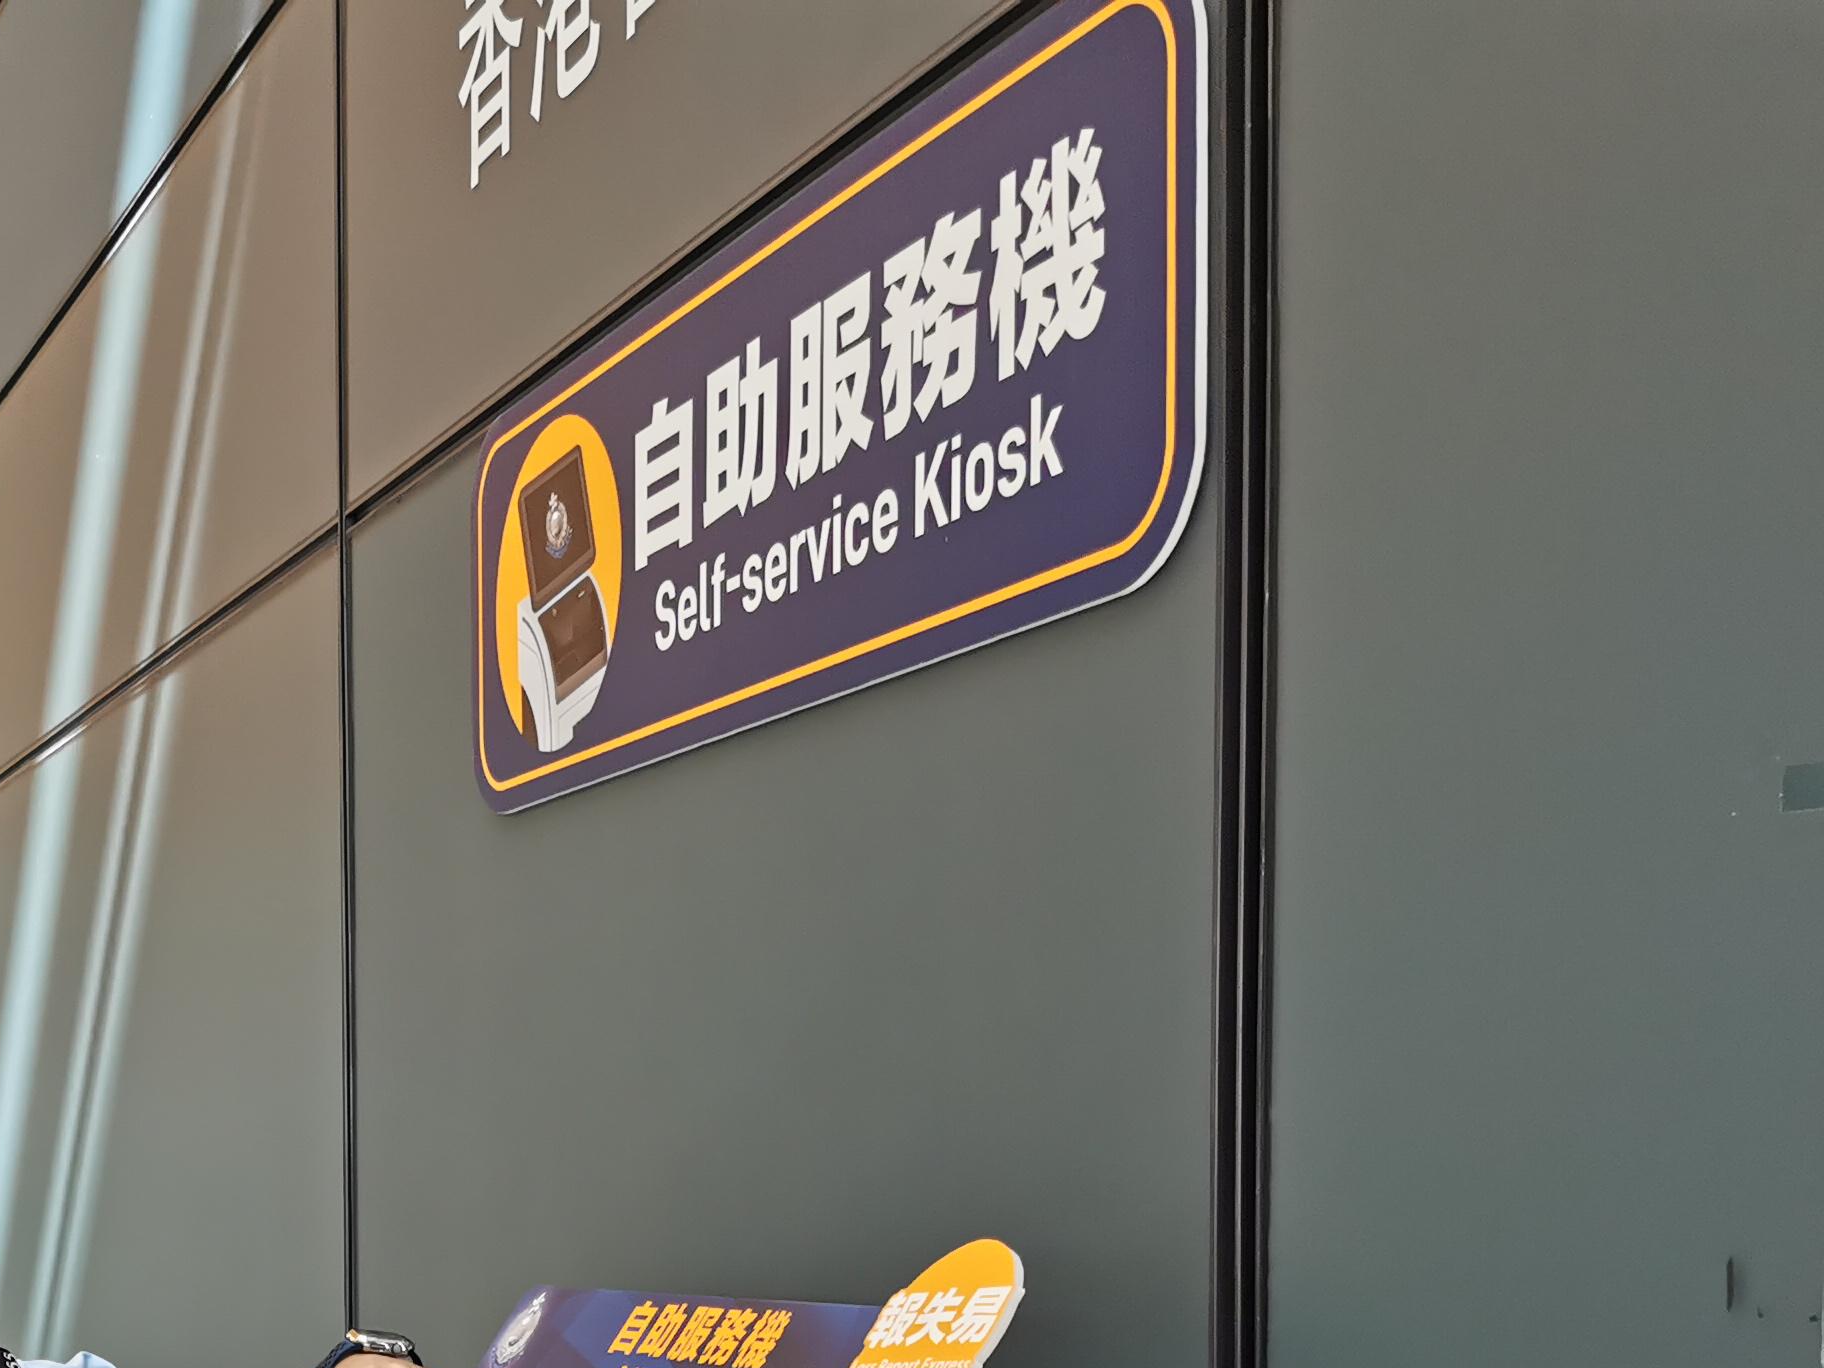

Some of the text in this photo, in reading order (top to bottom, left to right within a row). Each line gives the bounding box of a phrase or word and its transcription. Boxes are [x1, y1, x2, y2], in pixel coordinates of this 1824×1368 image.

[458, 0, 656, 189] 香港
[631, 128, 1107, 571] 自助服務機
[654, 393, 1064, 653] Self-service Kiosk
[865, 1286, 1012, 1349] 報失易
